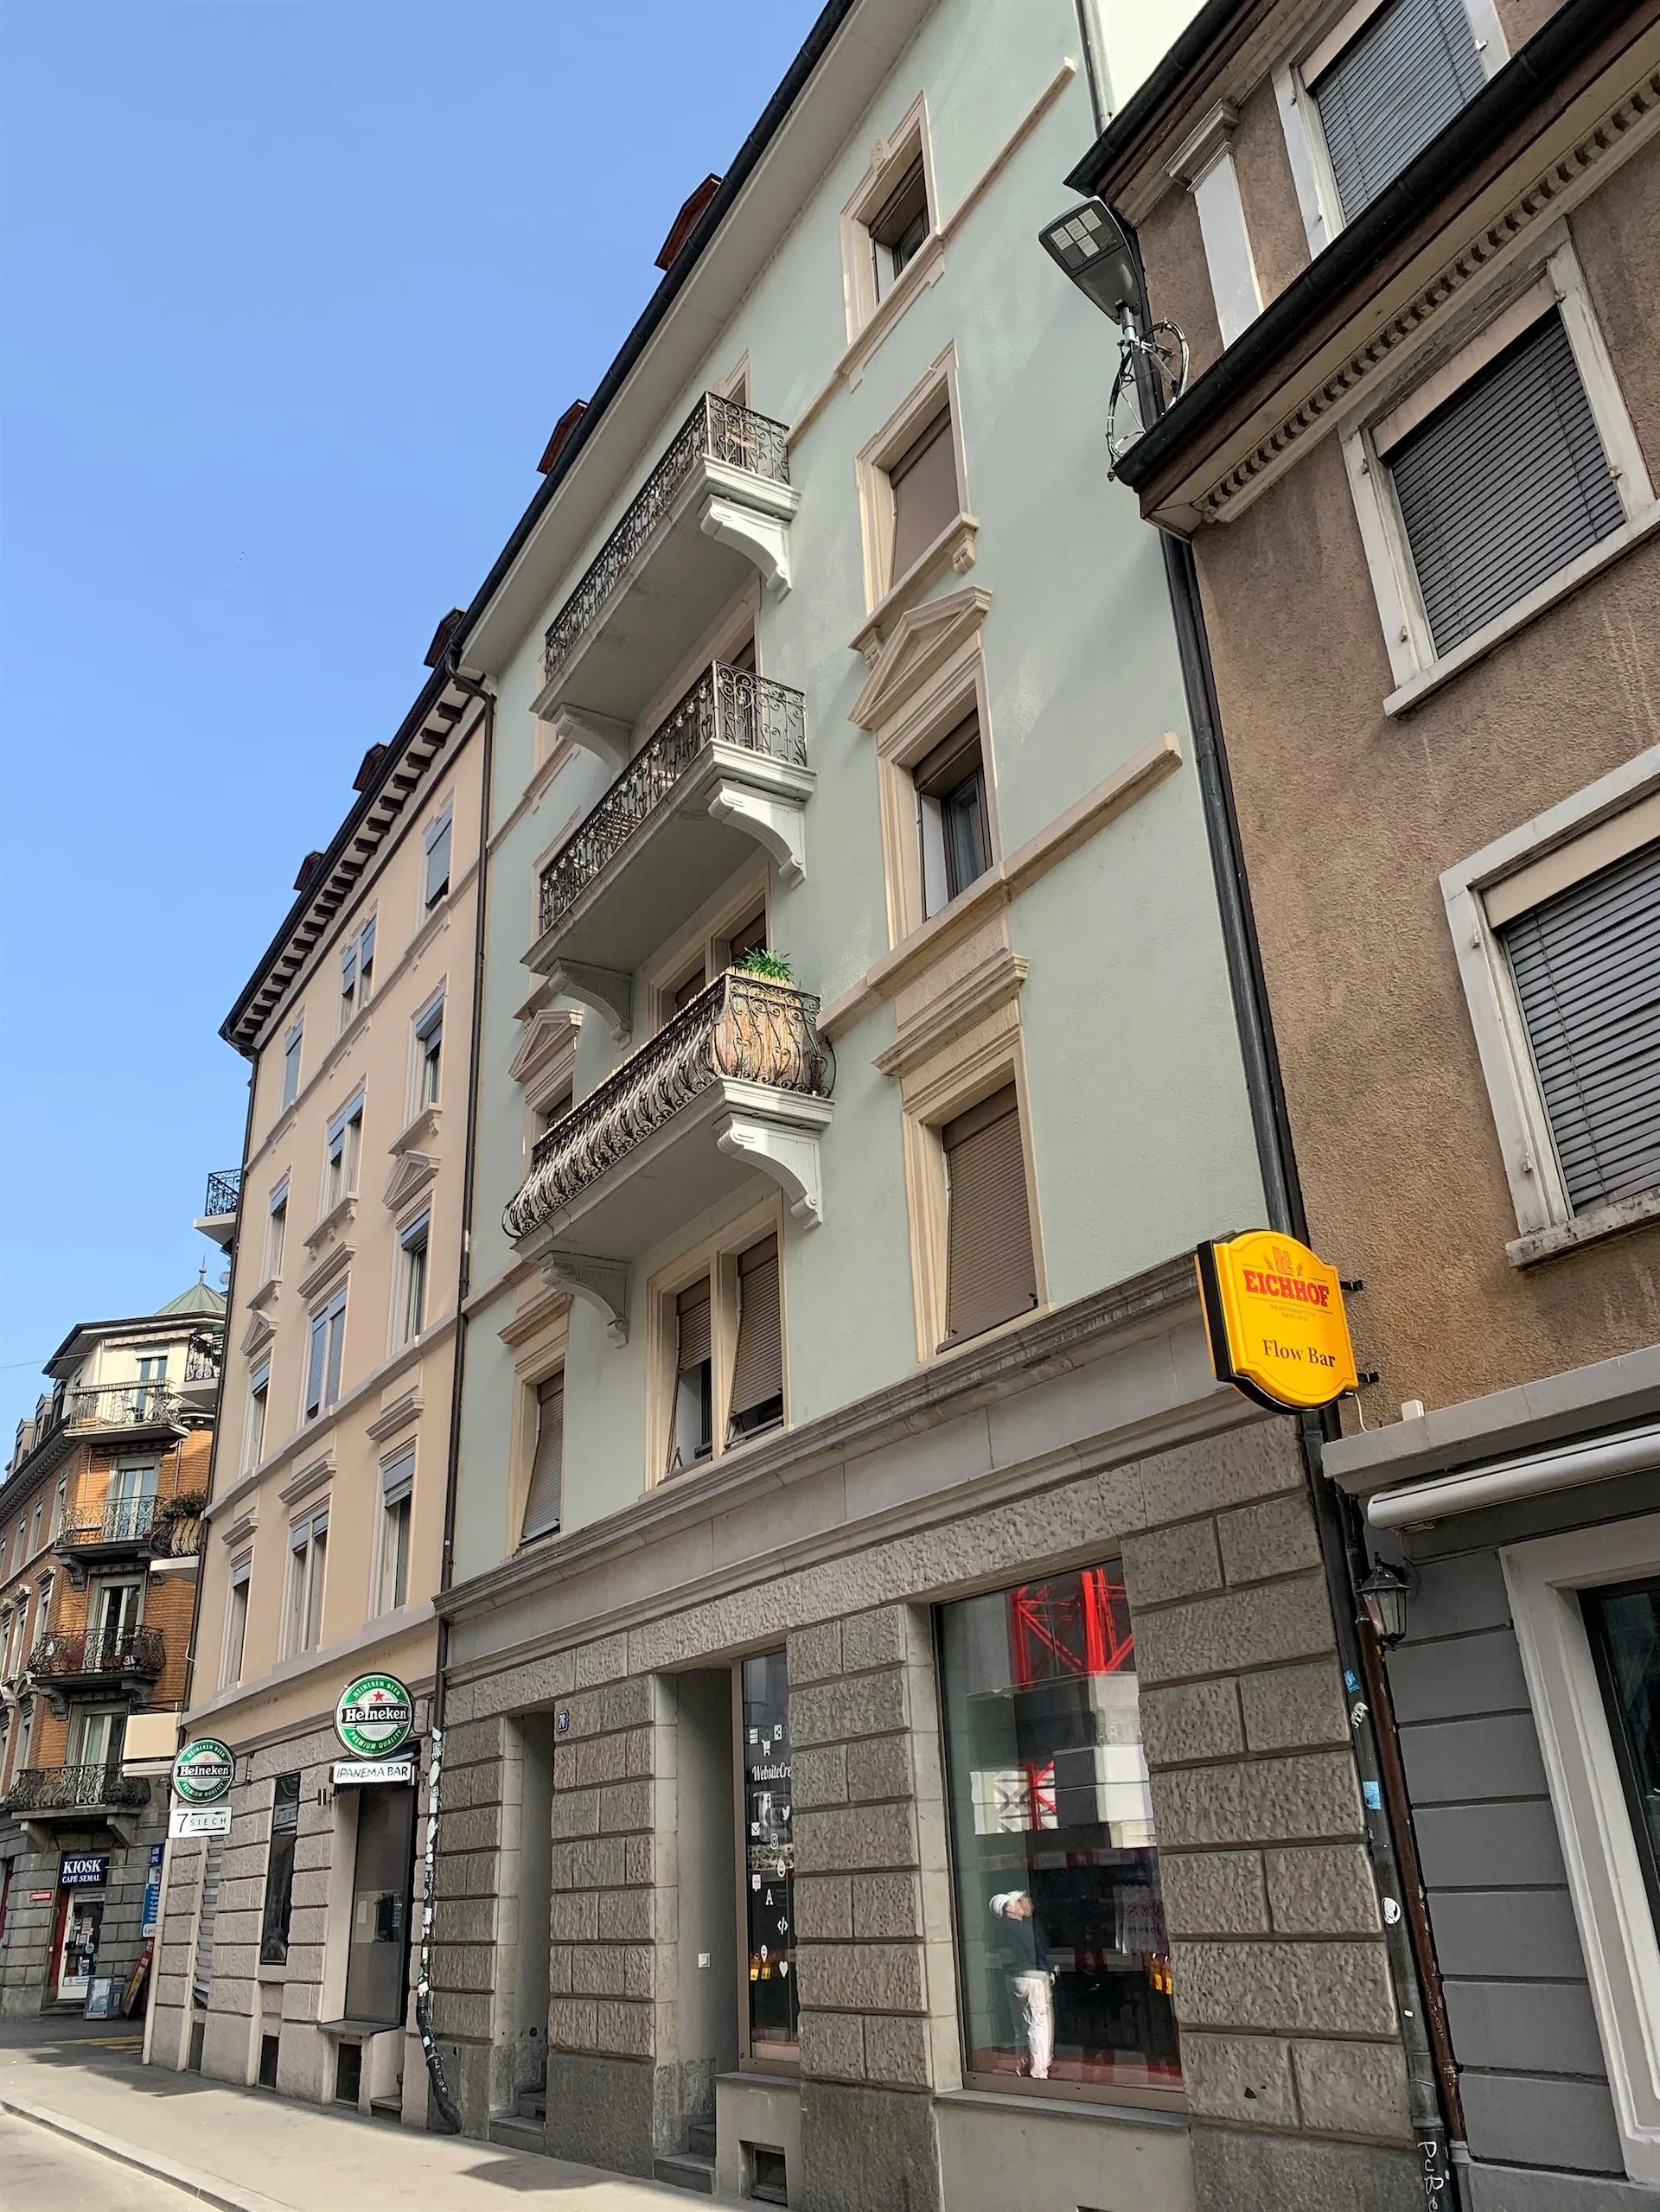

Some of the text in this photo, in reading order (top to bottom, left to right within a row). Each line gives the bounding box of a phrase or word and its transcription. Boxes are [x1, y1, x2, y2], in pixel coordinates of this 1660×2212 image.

[1242, 1270, 1330, 1307] EICHHOF
[1261, 1339, 1336, 1367] Flow Bar
[353, 1680, 401, 1698] HEINEKEN BEER
[345, 1706, 407, 1722] Heineken
[348, 1730, 402, 1750] PREMIUM QUALITY
[180, 1765, 229, 1776] Heineken
[336, 1765, 408, 1779] IPANEMA BAR
[176, 1814, 227, 1833] 7 SIECH
[62, 1859, 102, 1874] KIOSK
[79, 1874, 101, 1883] SEMAL
